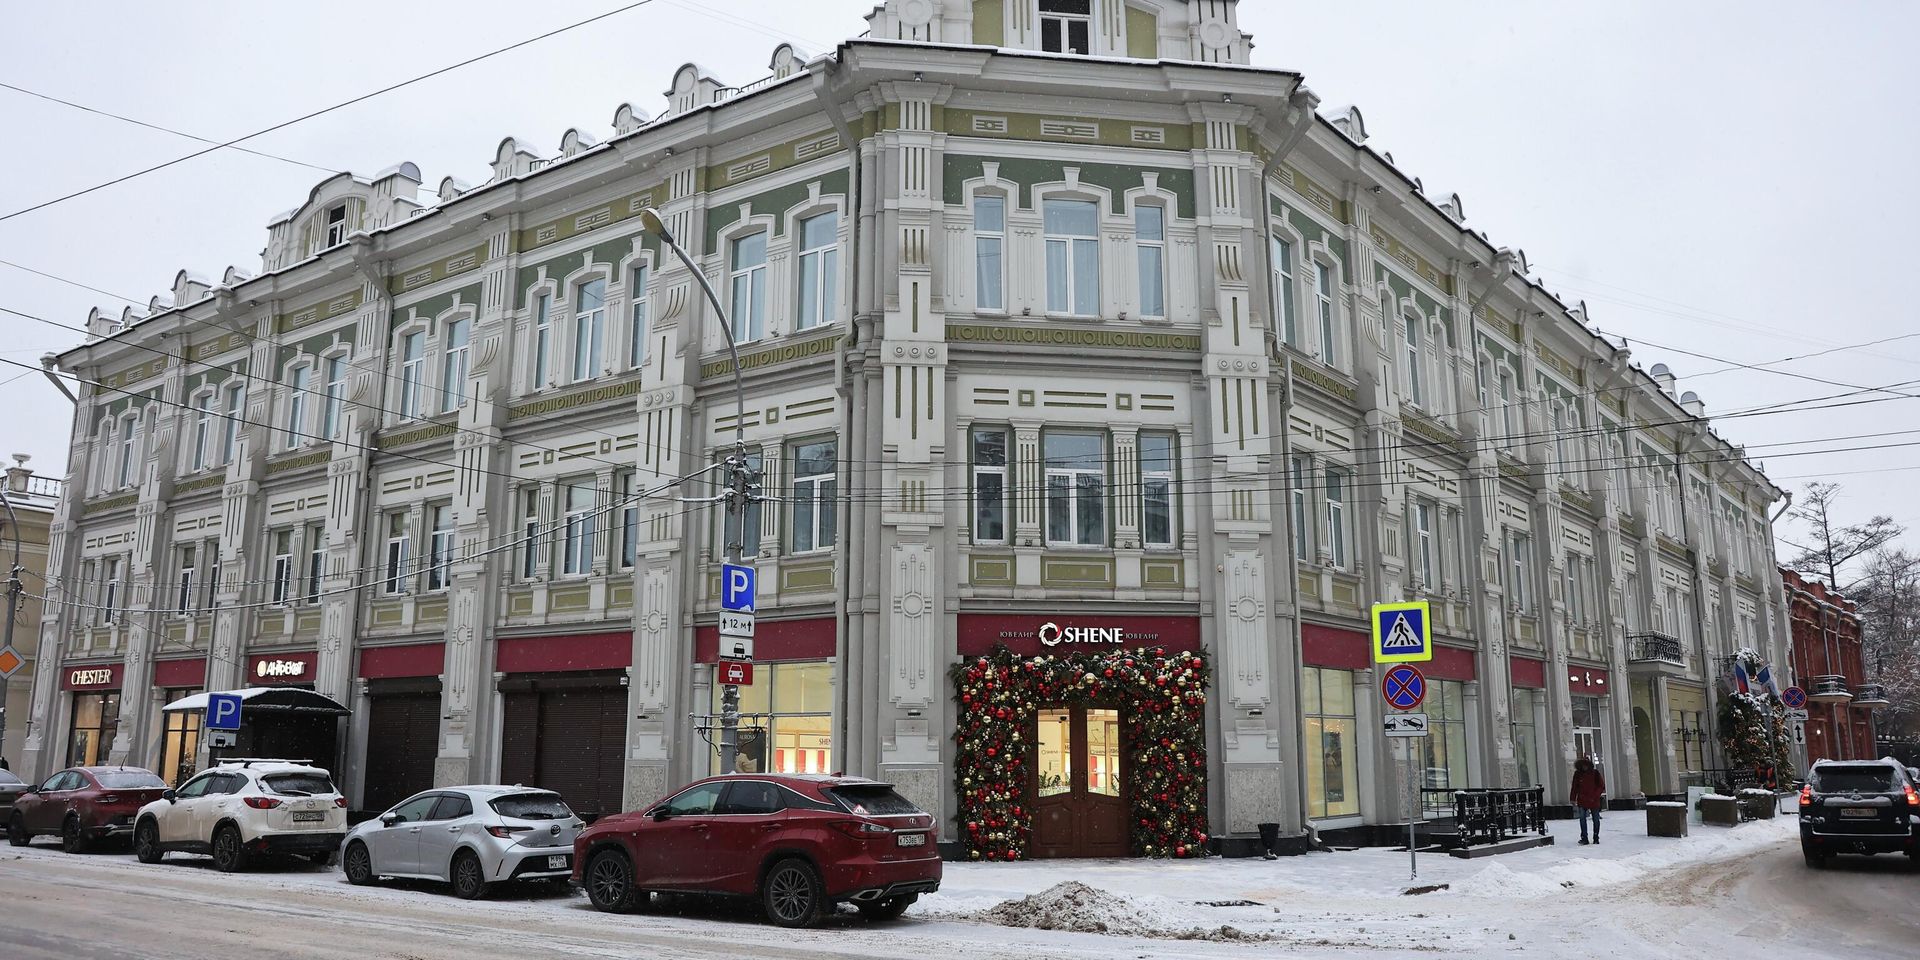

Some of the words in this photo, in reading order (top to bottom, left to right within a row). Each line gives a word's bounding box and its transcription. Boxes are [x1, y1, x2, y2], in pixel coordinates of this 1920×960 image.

[730, 569, 749, 603] P
[730, 618, 738, 629] 12
[1064, 627, 1124, 643] SHENE
[1125, 632, 1159, 640] ЮВЕЛИР
[71, 669, 112, 685] CHESTER
[215, 698, 236, 724] P
